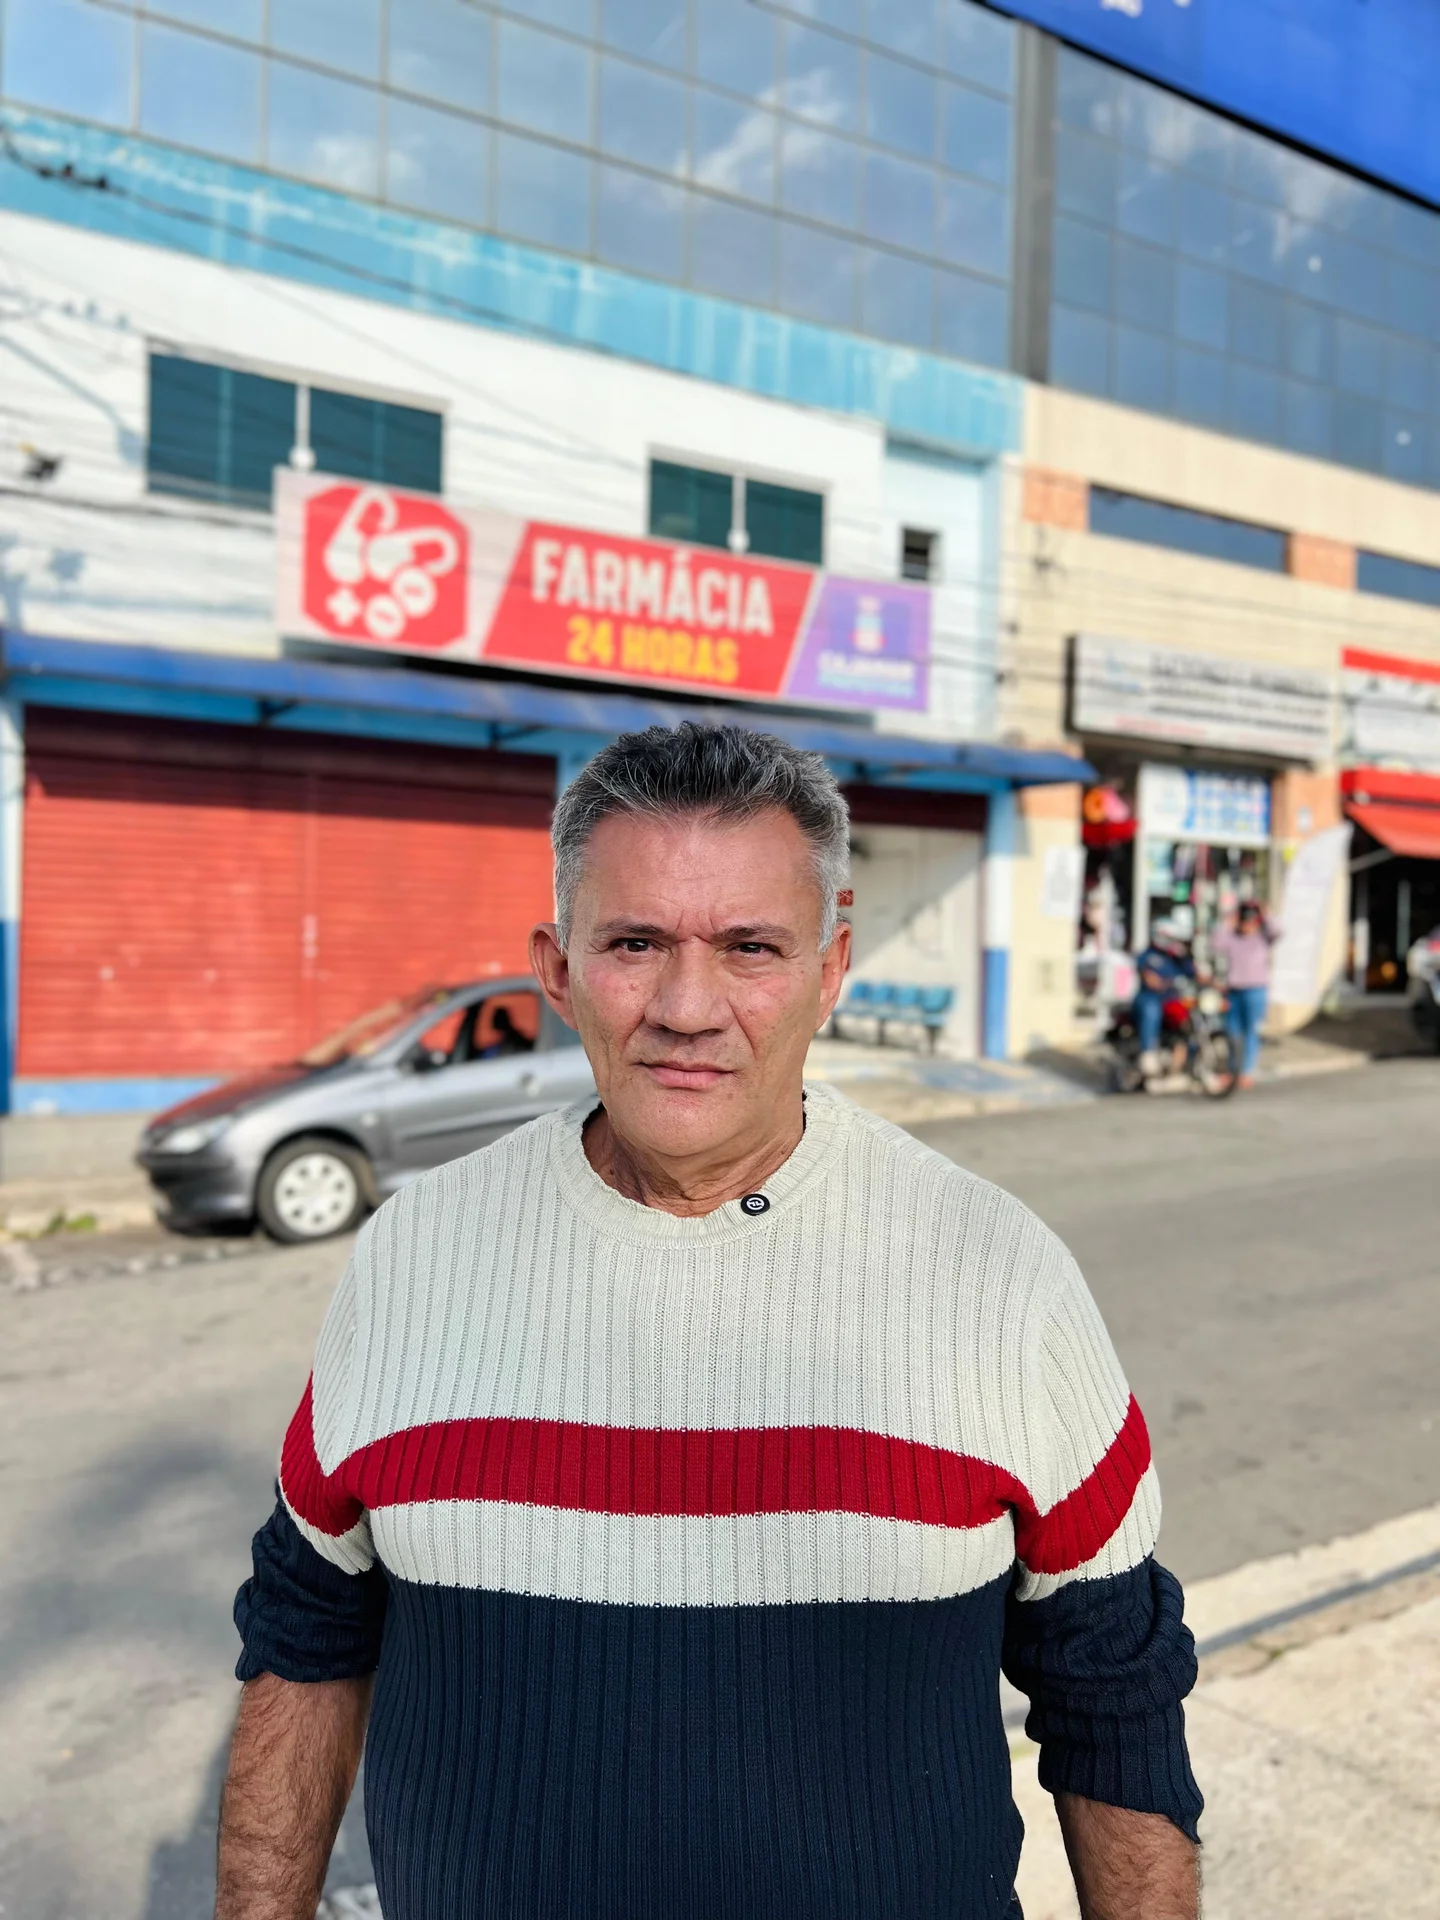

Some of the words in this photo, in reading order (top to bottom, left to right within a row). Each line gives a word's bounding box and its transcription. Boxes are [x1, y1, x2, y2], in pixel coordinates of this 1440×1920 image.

[532, 539, 773, 636] FARMÁCIA
[567, 615, 614, 666] 24
[620, 624, 740, 684] HORAS
